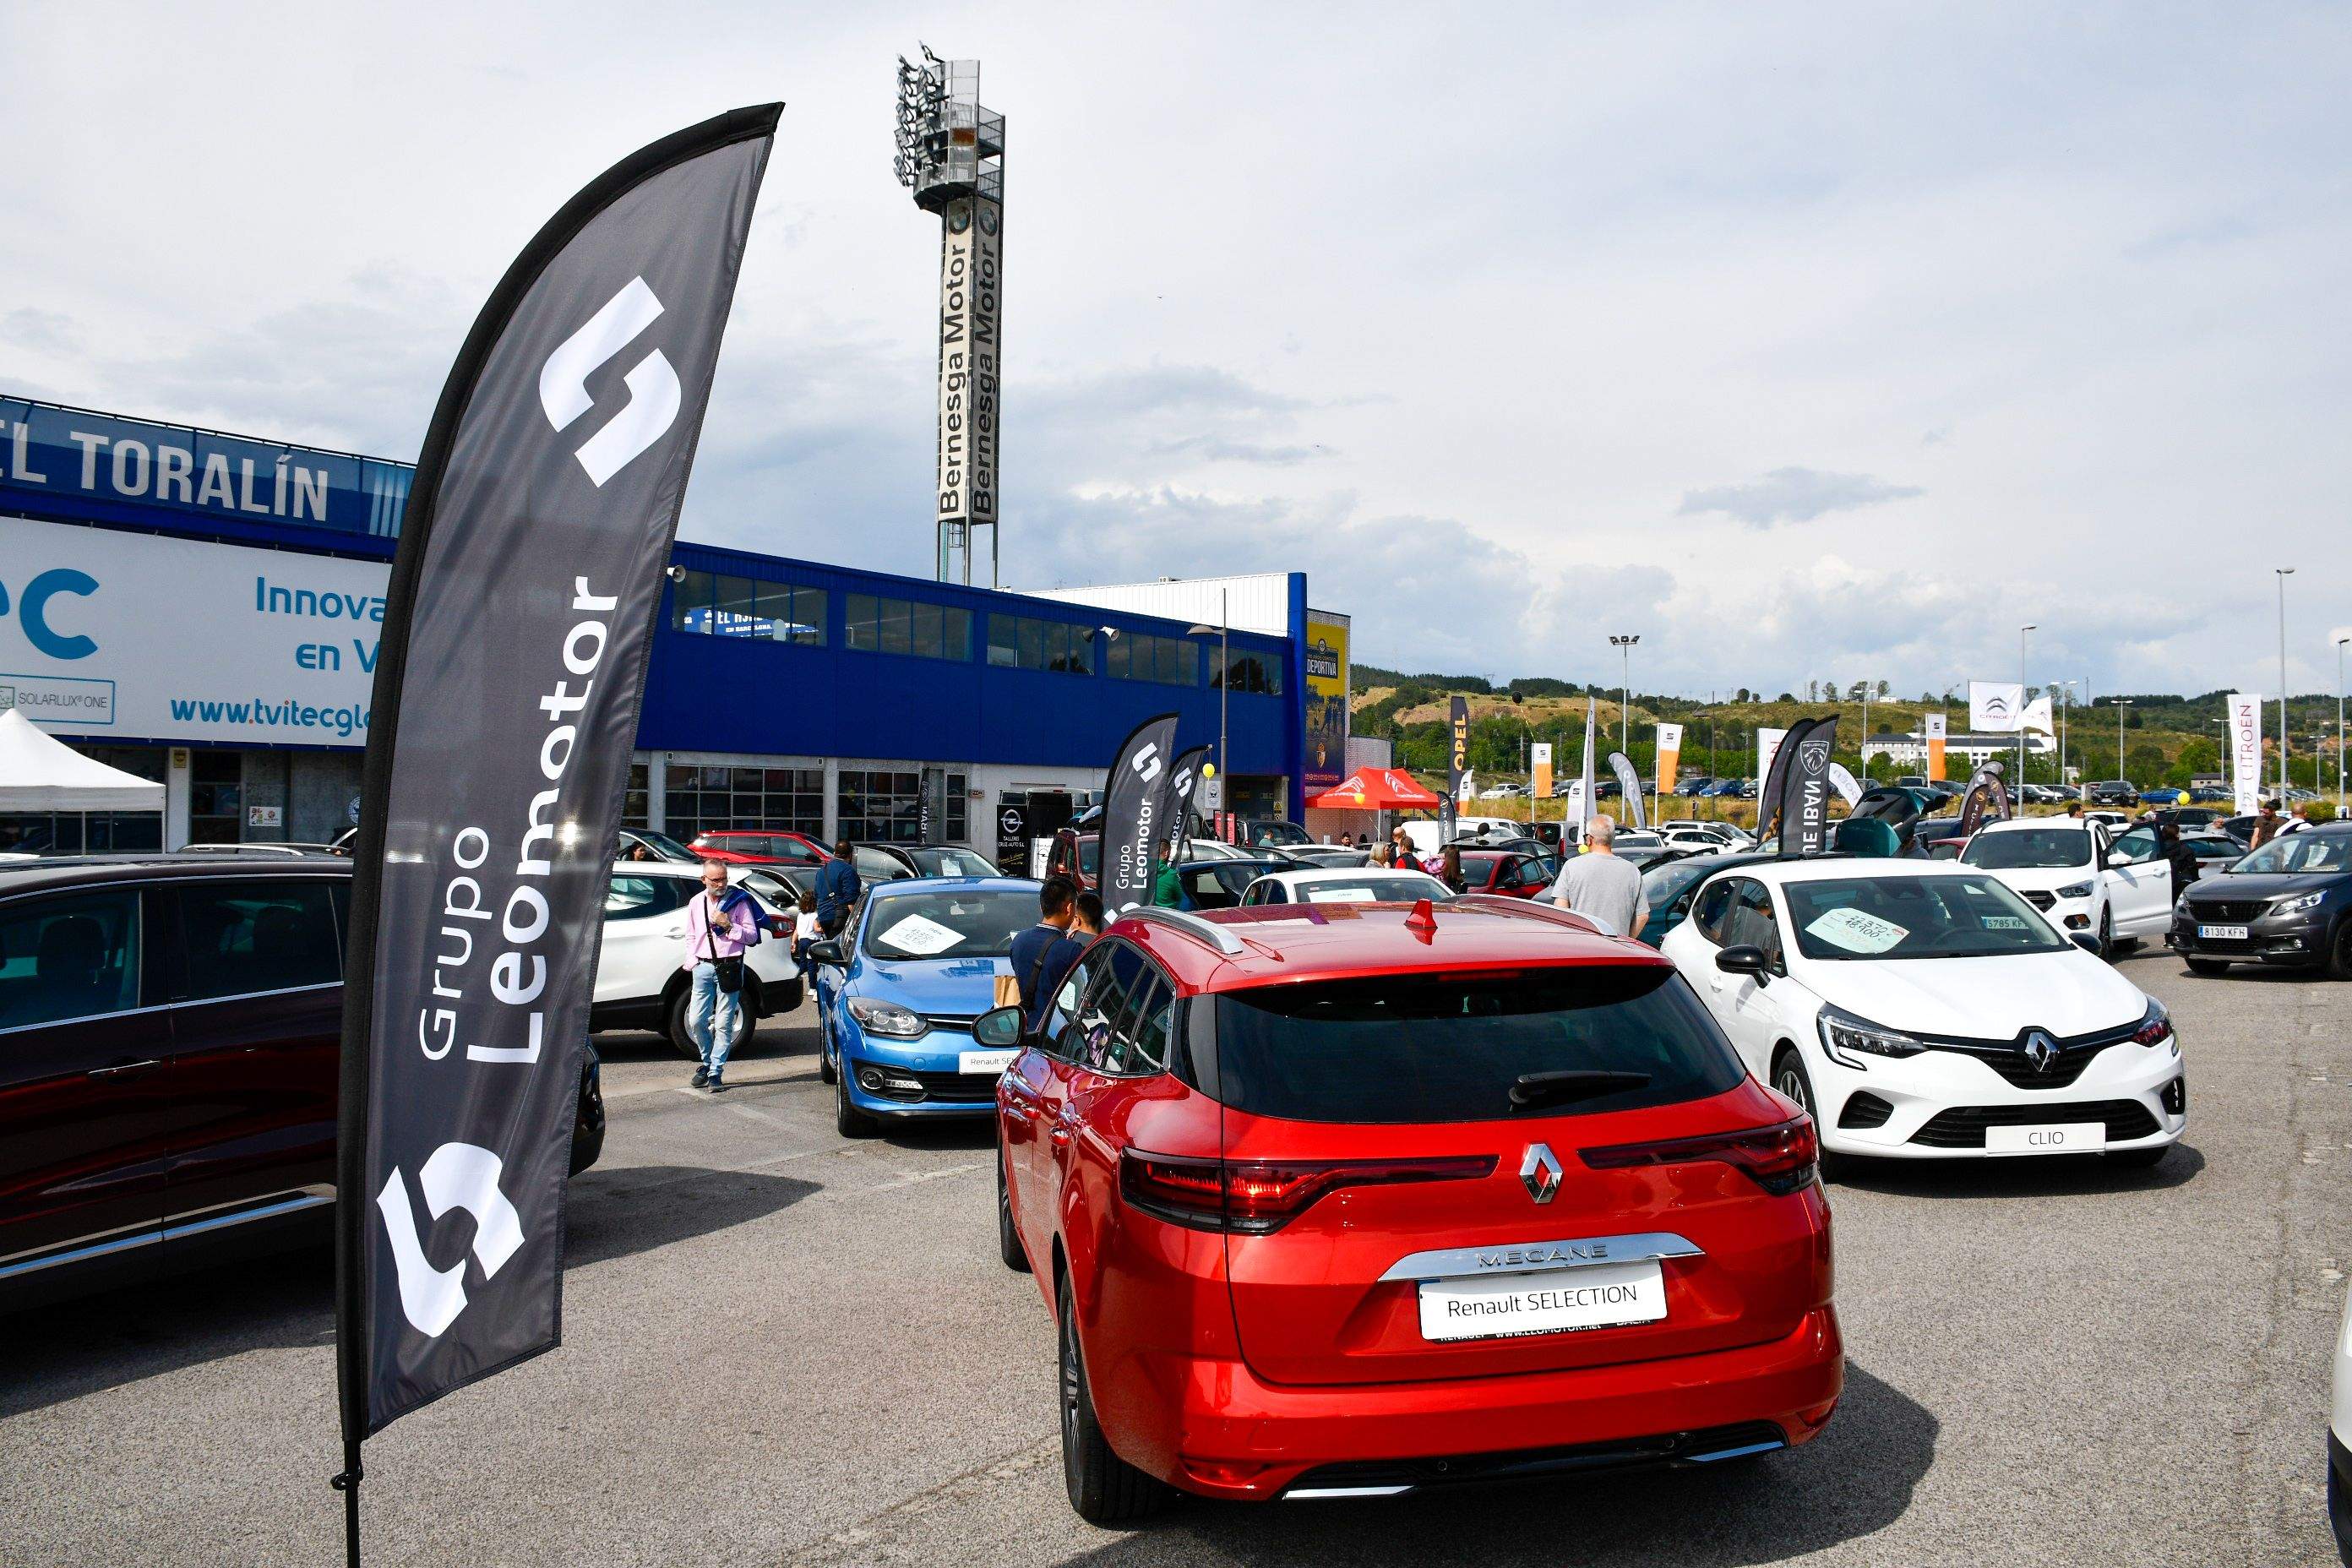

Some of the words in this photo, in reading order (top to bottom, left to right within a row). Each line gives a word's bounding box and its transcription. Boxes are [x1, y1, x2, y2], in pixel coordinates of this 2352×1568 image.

[944, 244, 966, 345] Motor
[975, 242, 996, 345] Motor
[939, 351, 966, 514] Bernesga
[973, 353, 998, 515] Bernesga
[69, 431, 329, 521] TORALÍN
[295, 643, 340, 672] en
[1307, 658, 1337, 677] DEPORTIVA
[84, 695, 107, 708] ONE
[1454, 713, 1467, 771] OPEL
[466, 575, 618, 1064] Leomotor
[1132, 798, 1152, 889] Leomotor
[1115, 844, 1134, 890] Grupo
[419, 825, 493, 1062] Grupo
[2204, 928, 2224, 937] 8130
[2227, 928, 2245, 937] KFH
[2028, 1131, 2064, 1146] CLIO
[1447, 1294, 1522, 1318] Renault
[1527, 1284, 1637, 1311] SELECTION
